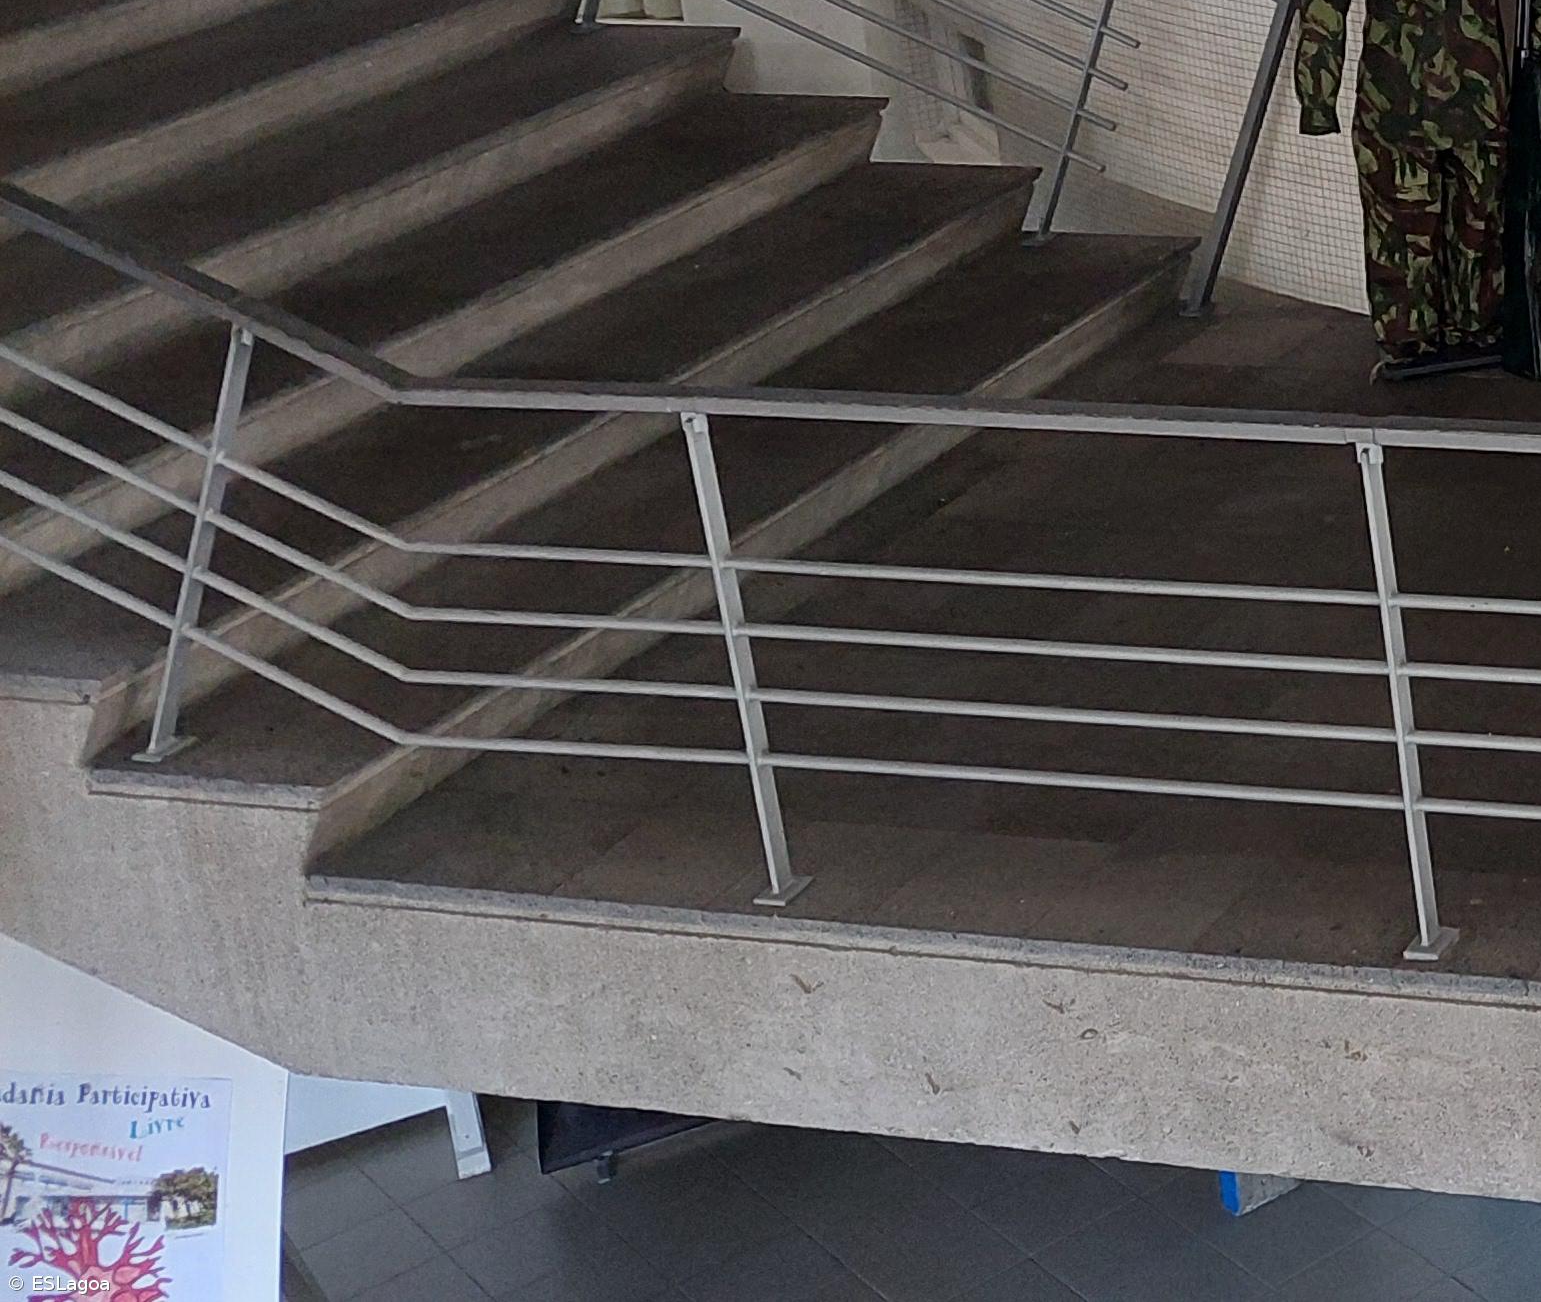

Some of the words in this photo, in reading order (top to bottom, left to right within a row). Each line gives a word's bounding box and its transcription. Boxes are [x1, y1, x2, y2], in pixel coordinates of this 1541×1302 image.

[0, 1081, 65, 1106] dania
[76, 1083, 211, 1113] Participativa
[129, 1116, 185, 1139] Livre
